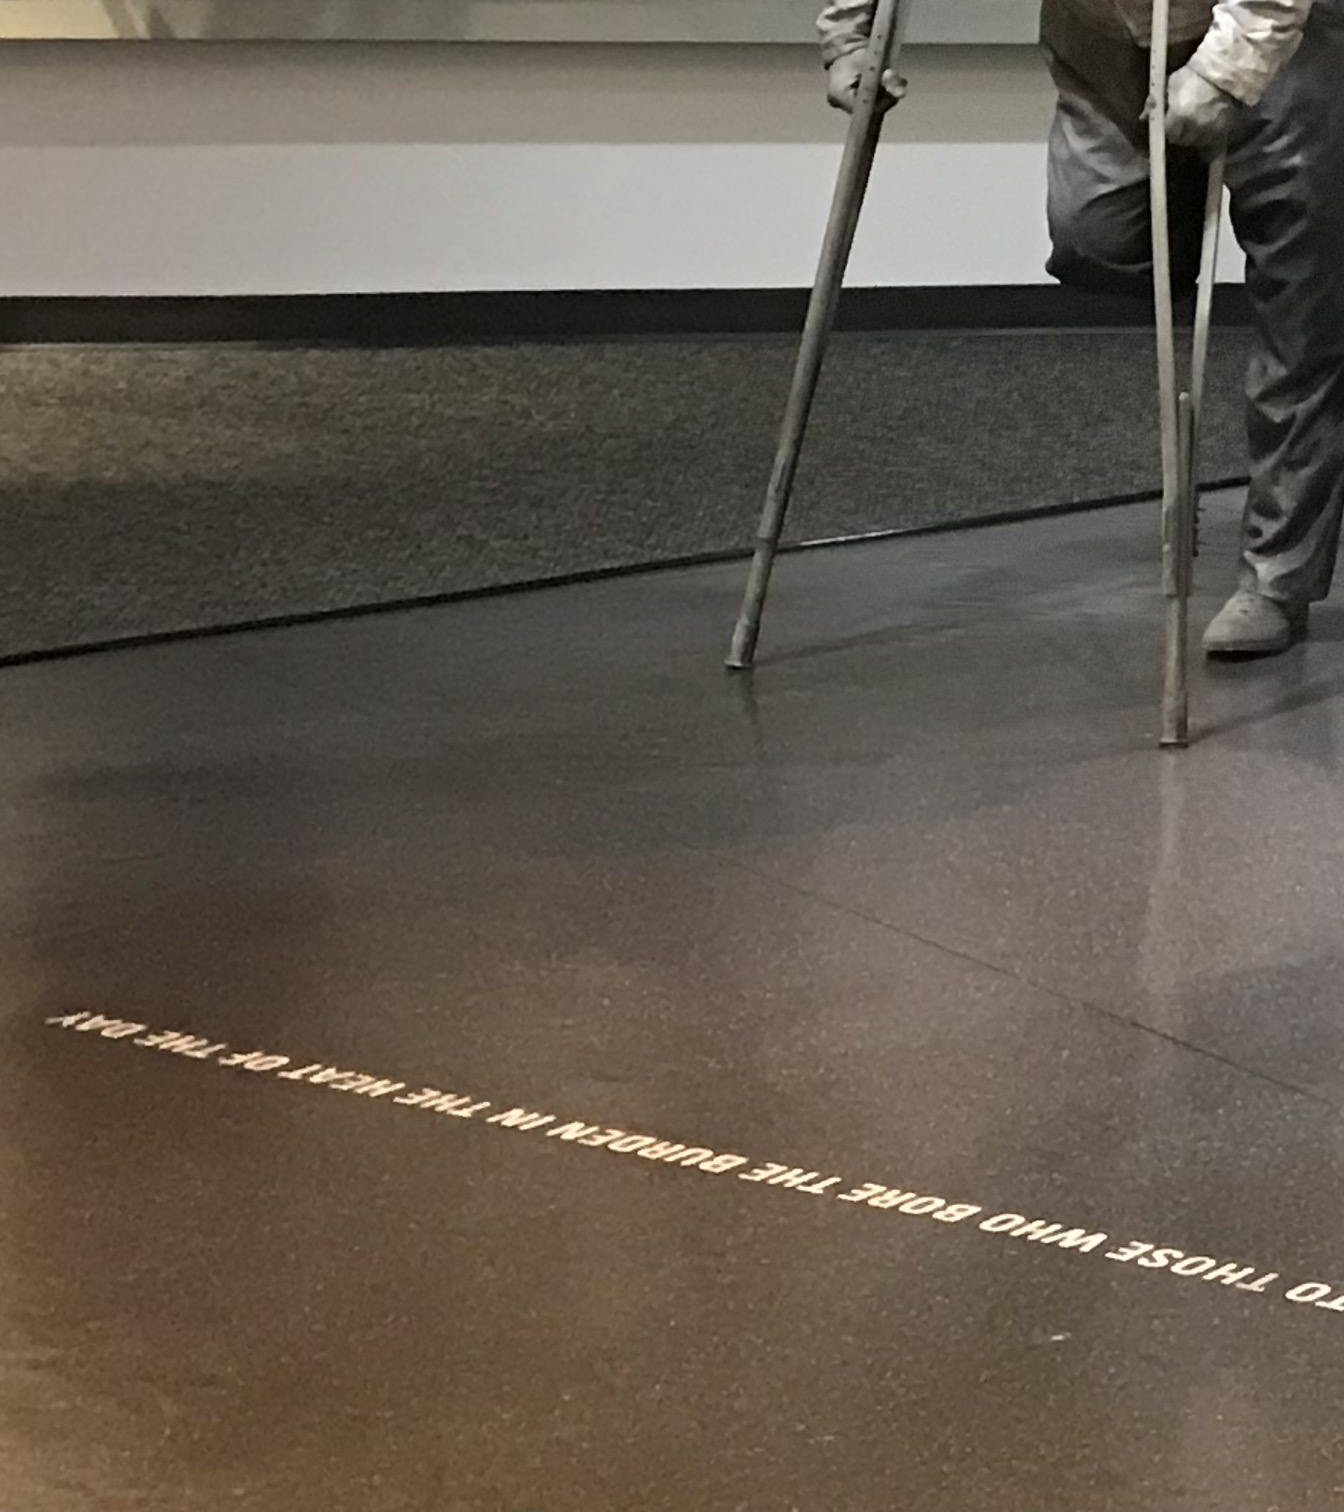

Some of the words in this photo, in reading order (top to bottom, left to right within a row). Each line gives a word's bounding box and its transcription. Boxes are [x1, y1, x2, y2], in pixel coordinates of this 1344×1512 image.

[45, 1011, 147, 1039] DAY
[133, 1030, 227, 1059] THE
[218, 1051, 291, 1072] OF
[277, 1063, 406, 1097] HEAT
[393, 1087, 491, 1118] THE
[486, 1108, 557, 1131] IN
[546, 1121, 749, 1174] BURDEN
[738, 1162, 842, 1194] THE
[837, 1182, 983, 1223] BORE
[979, 1213, 1108, 1253] WHO
[1105, 1240, 1279, 1292] THOSE
